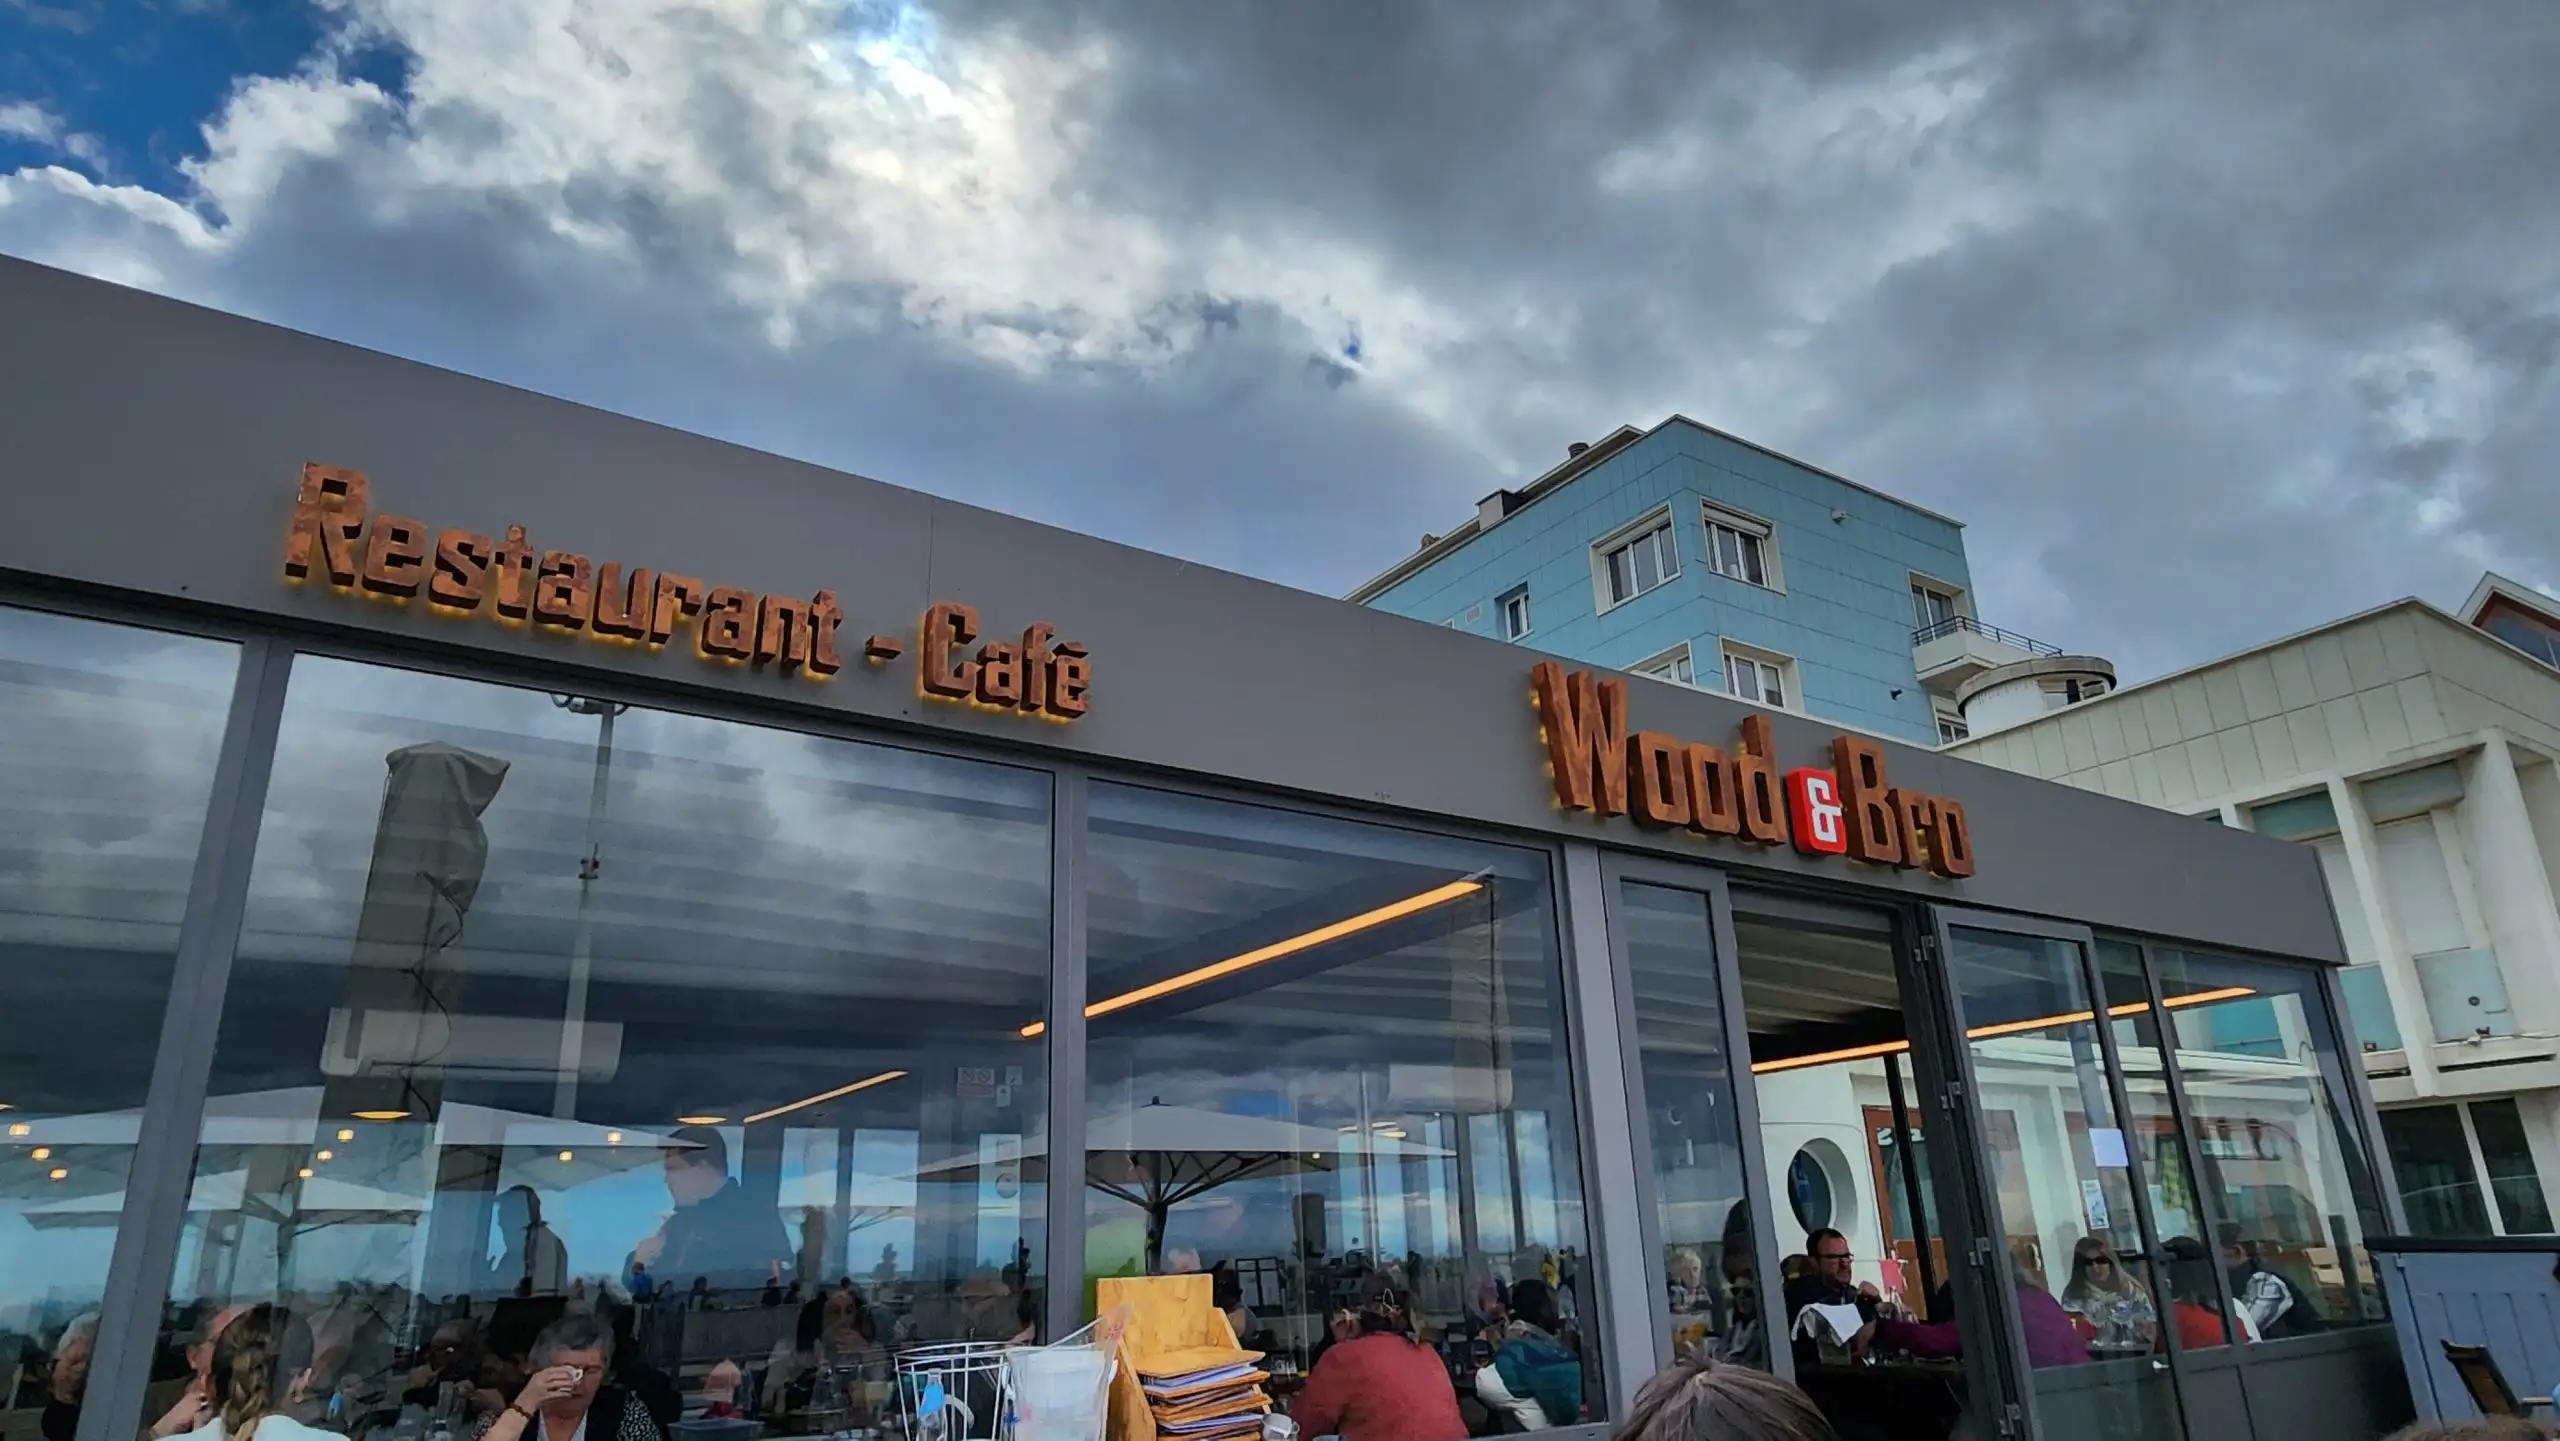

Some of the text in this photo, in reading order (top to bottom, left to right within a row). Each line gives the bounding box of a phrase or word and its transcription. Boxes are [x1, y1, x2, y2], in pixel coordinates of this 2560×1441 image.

[284, 462, 844, 676] Restaurant
[922, 602, 1092, 720] Café
[1532, 661, 1789, 846] Wood
[1832, 735, 1975, 879] Bro
